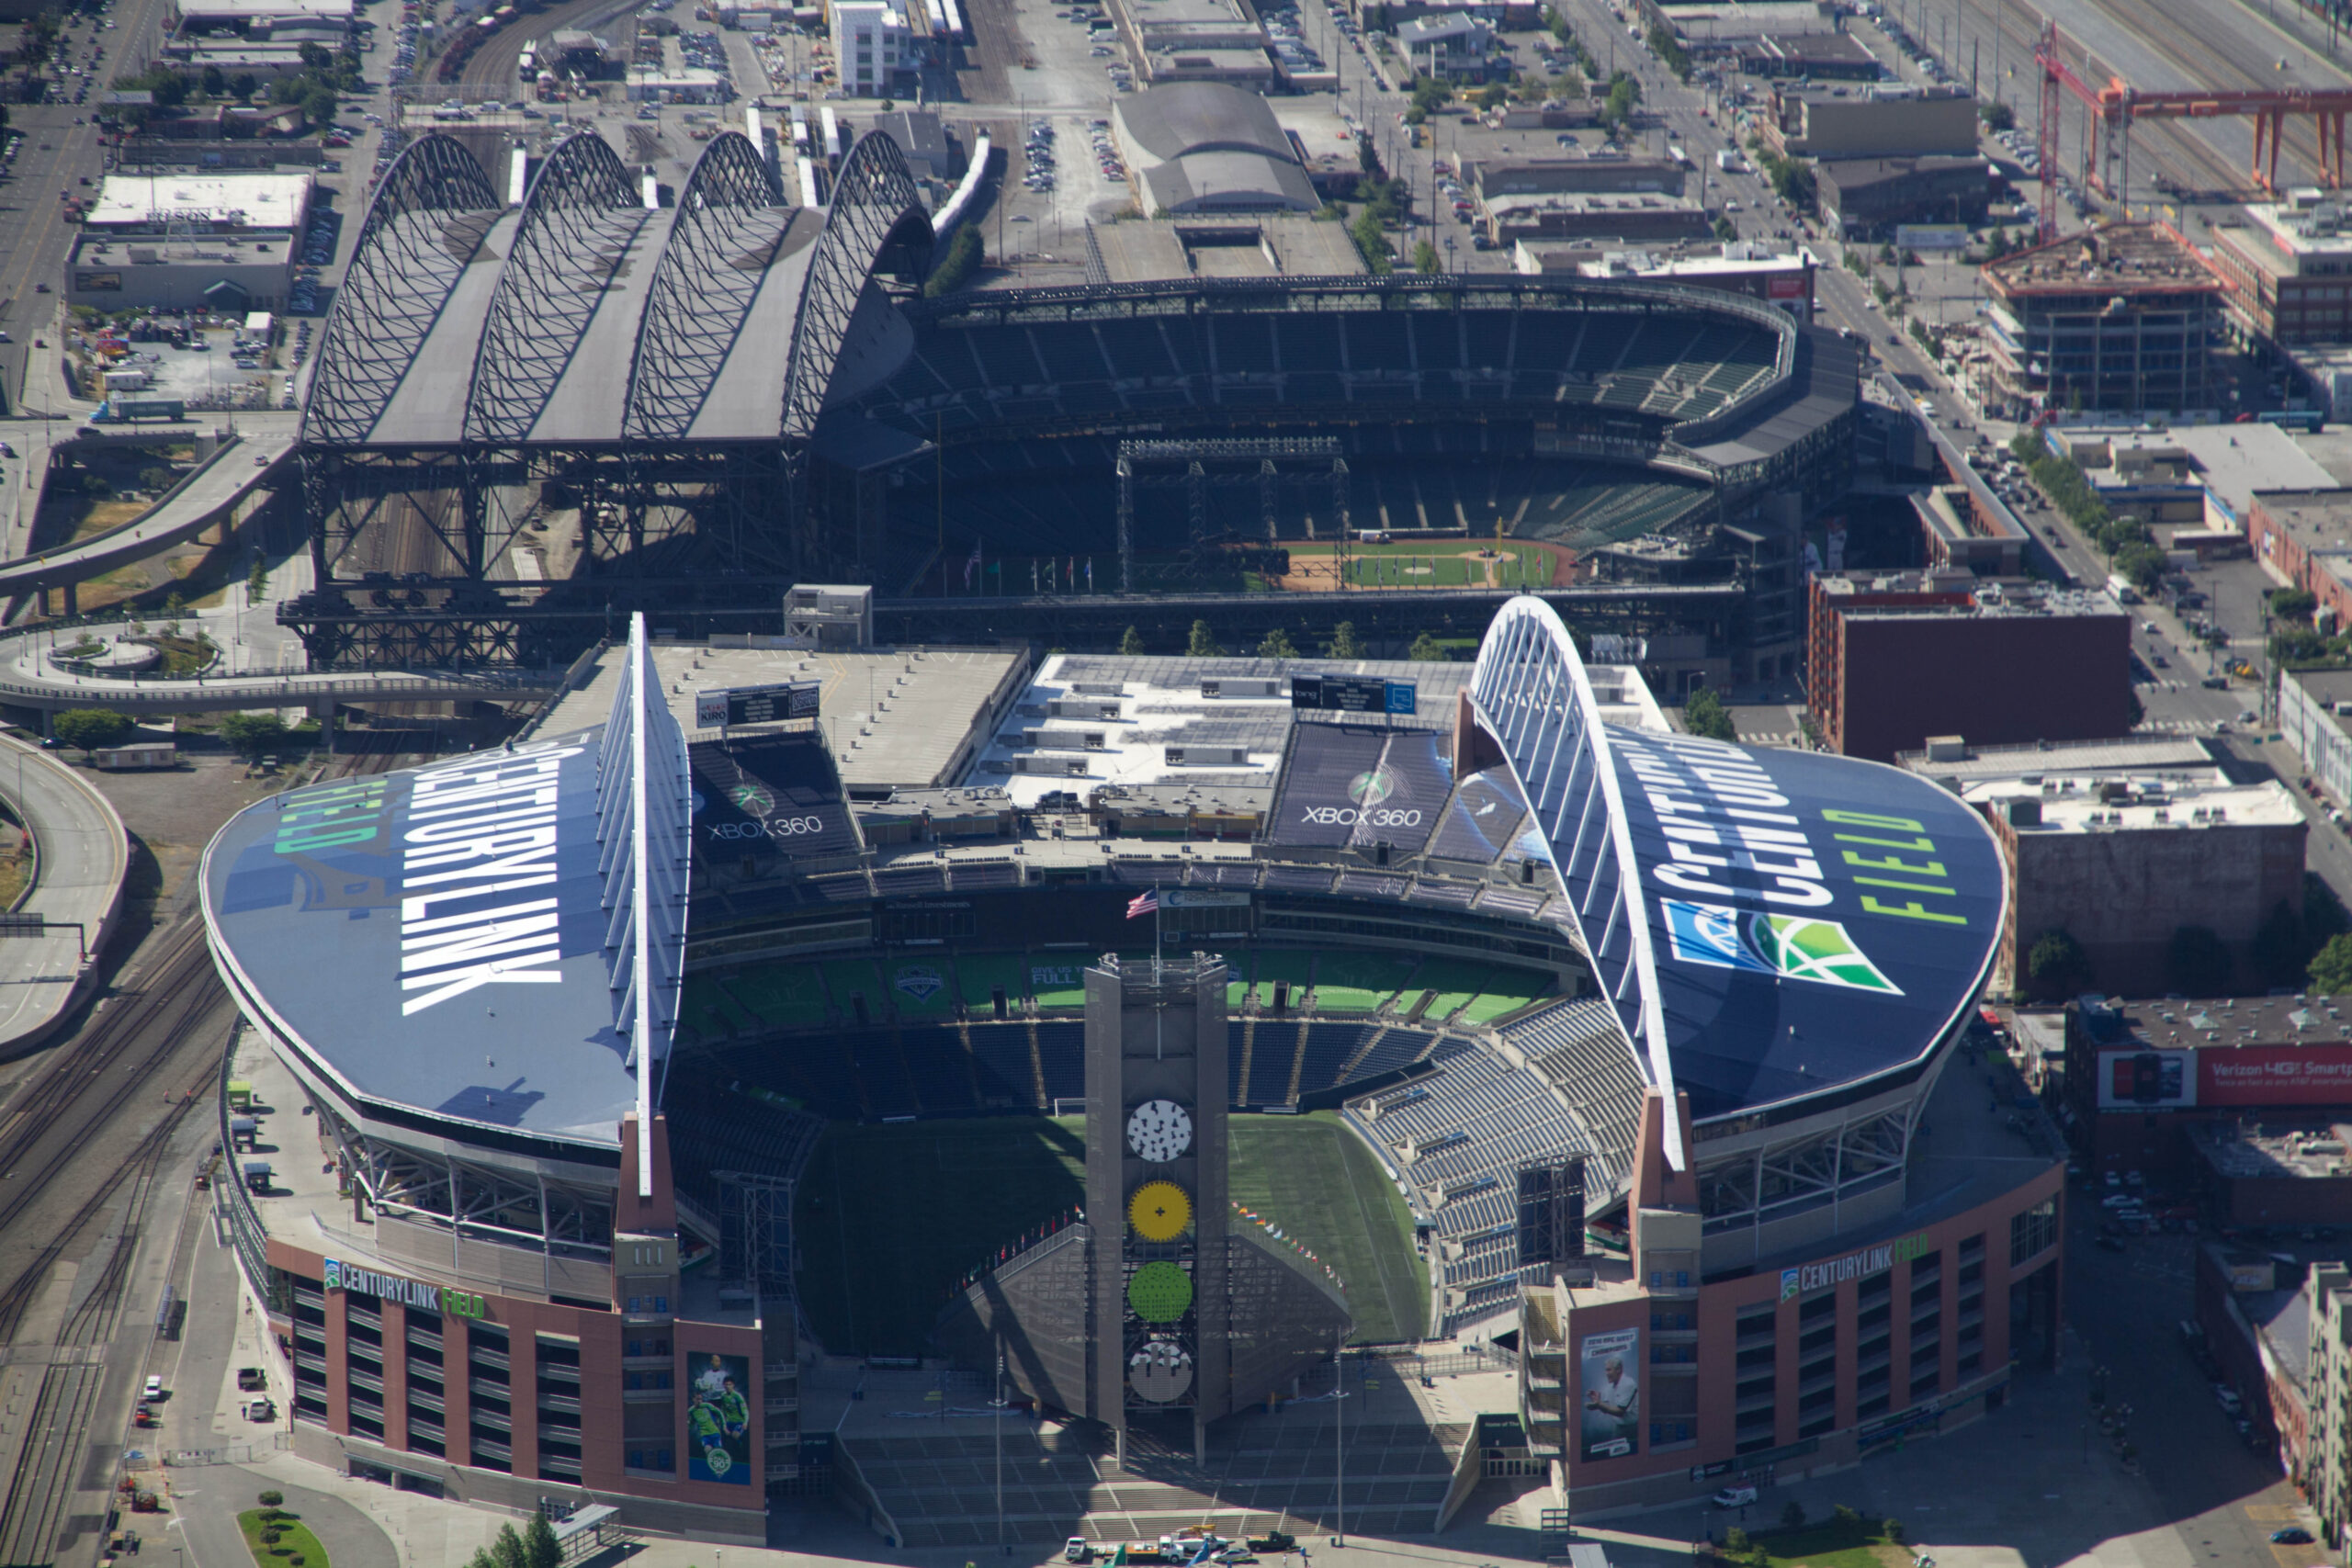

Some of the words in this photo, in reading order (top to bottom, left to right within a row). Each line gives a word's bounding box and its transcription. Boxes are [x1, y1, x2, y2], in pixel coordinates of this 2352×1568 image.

[1577, 434, 1638, 446] WELCOME
[1295, 690, 1317, 700] bing
[701, 711, 726, 722] KIRO
[275, 780, 390, 854] FIELD
[705, 815, 775, 841] XBOX
[775, 815, 823, 837] 360
[1300, 806, 1372, 826] XBOX
[1373, 808, 1422, 828] 360
[1820, 808, 1969, 926] FIELD
[1032, 974, 1077, 984] FULL
[2212, 1063, 2262, 1077] Verizon
[1801, 1244, 1893, 1292] CENTURYLINK
[1894, 1233, 1928, 1265] FIELD
[341, 1263, 438, 1311] CENTURYLINK
[442, 1286, 484, 1319] FIELD
